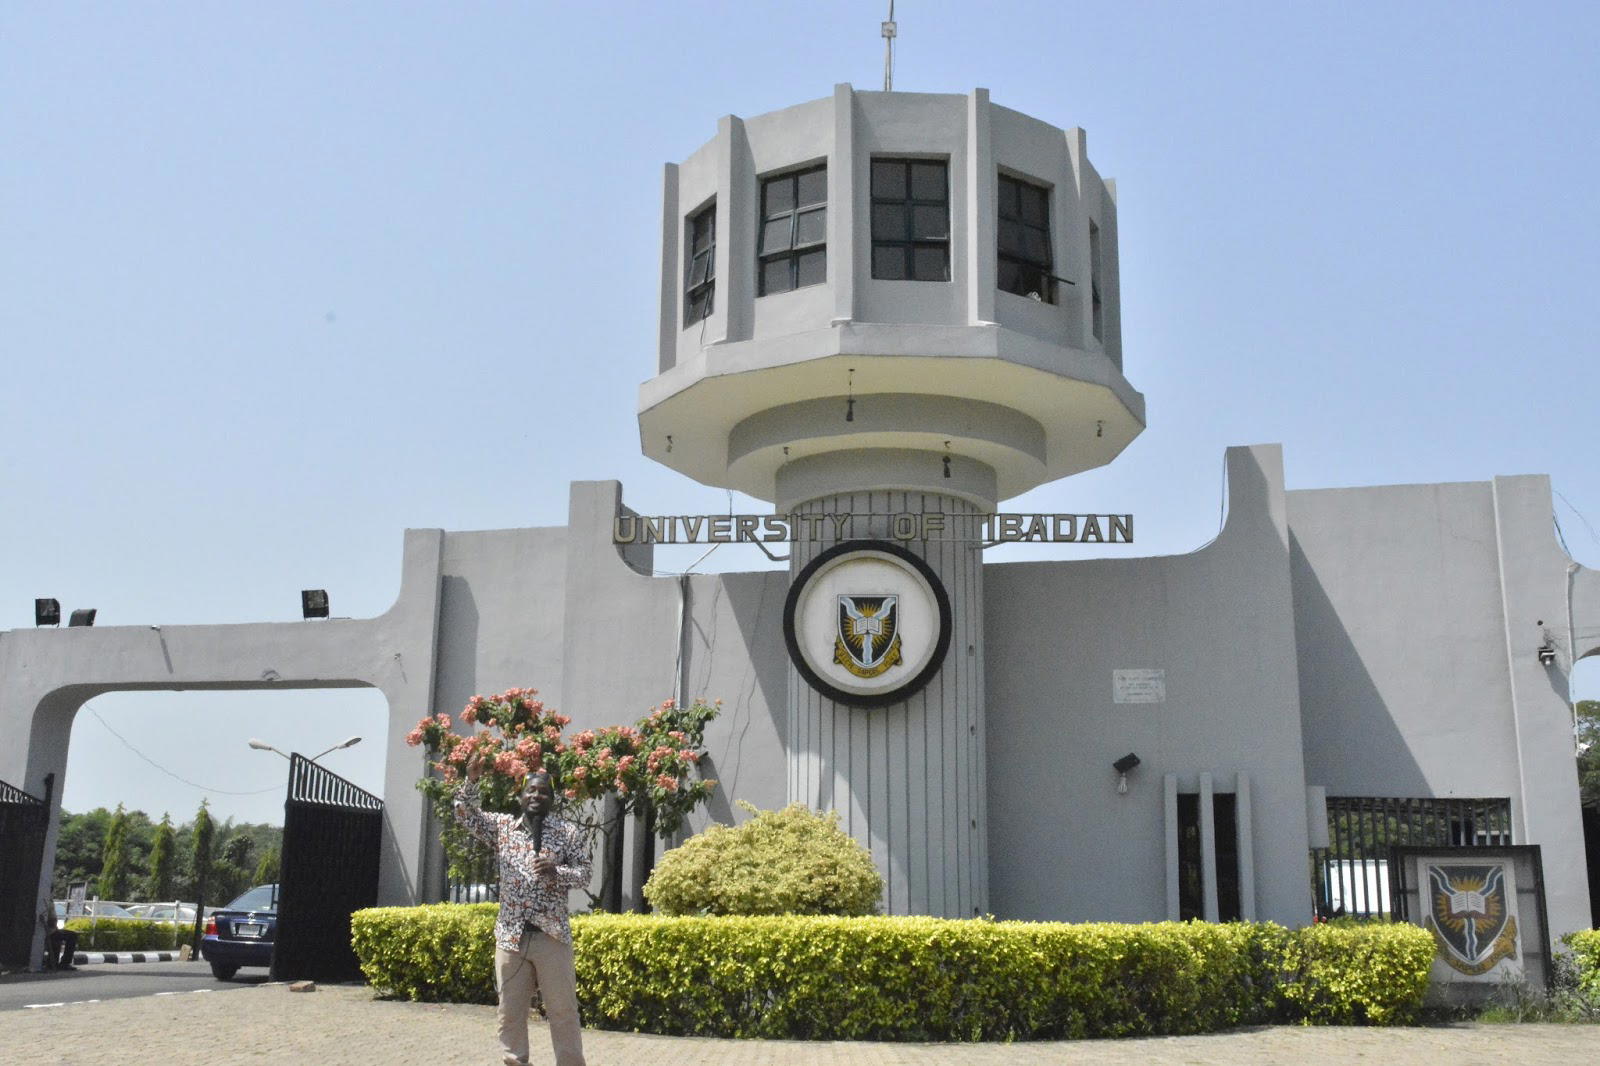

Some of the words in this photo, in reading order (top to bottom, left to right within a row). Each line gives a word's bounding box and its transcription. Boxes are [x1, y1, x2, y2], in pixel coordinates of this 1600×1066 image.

[613, 513, 850, 544] UNIVERSITY
[893, 512, 945, 541] OF
[987, 513, 1133, 543] IBADAN
